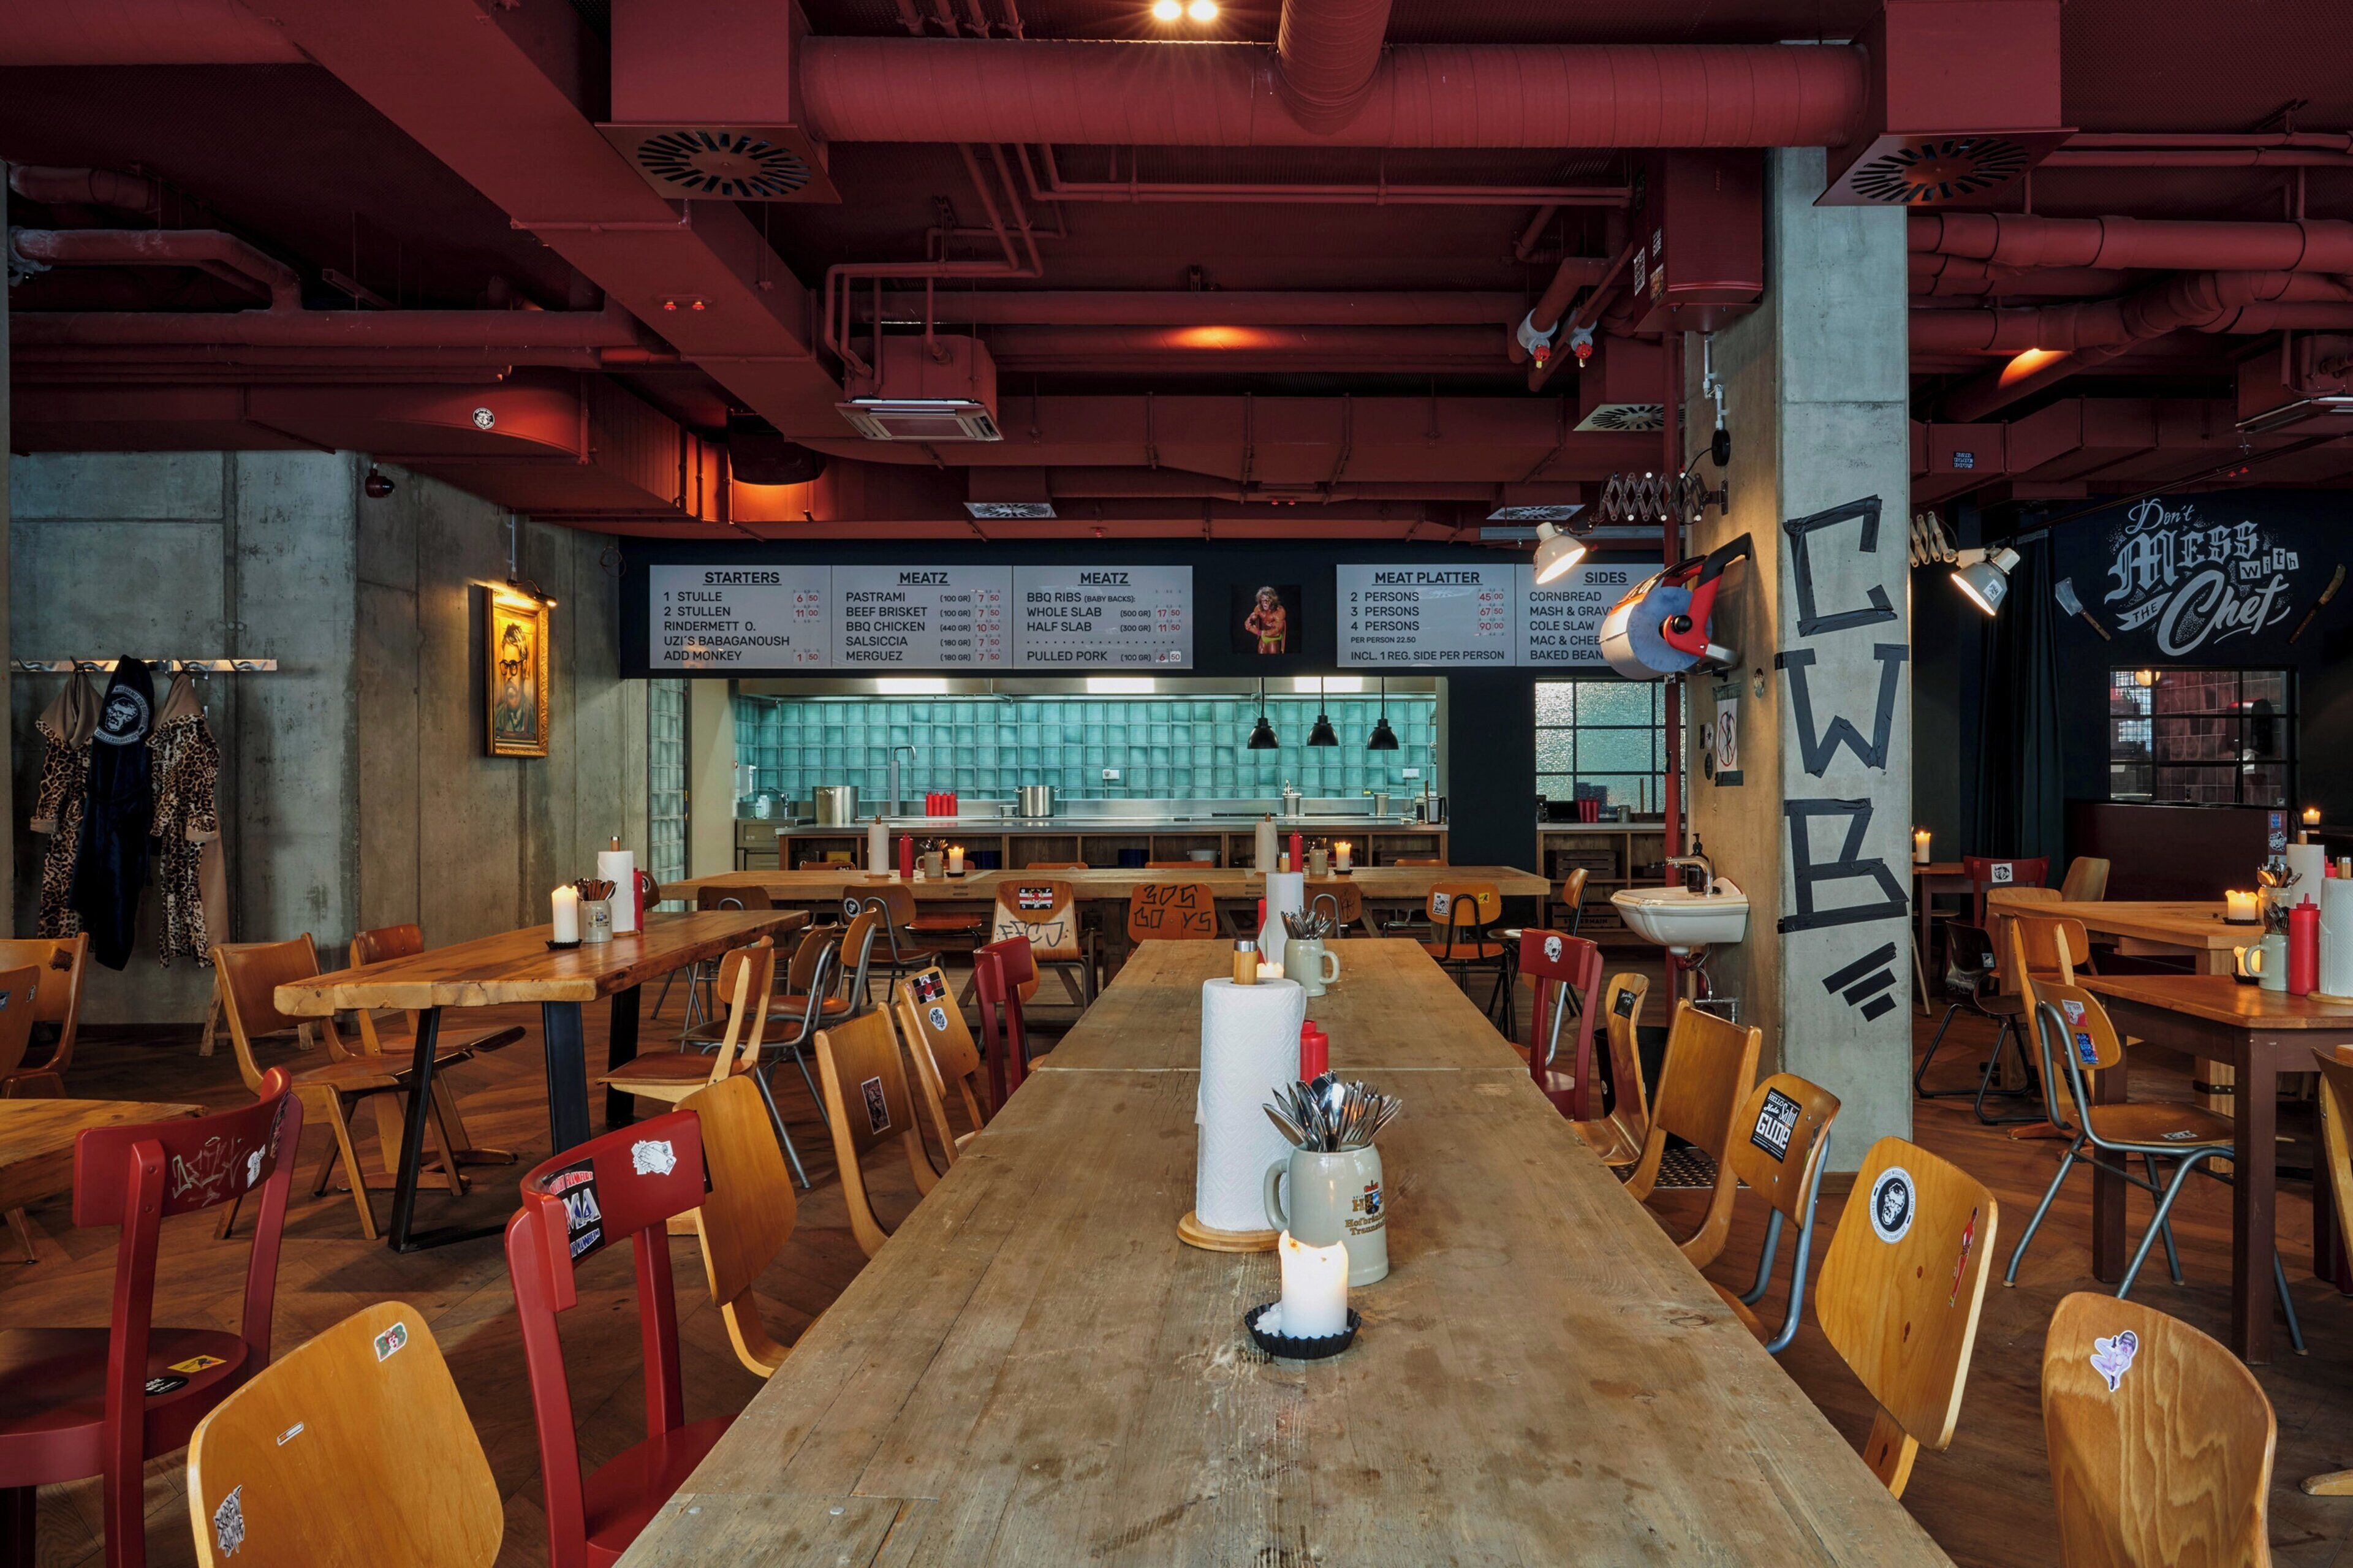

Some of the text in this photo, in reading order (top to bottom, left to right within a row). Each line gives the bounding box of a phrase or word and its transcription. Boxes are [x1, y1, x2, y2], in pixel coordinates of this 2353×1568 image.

[2124, 498, 2195, 534] Don't
[2240, 549, 2298, 578] with
[705, 572, 780, 583] STARTERS
[900, 572, 948, 584] MEATZ
[1080, 572, 1129, 584] MEATZ
[1375, 572, 1480, 584] MEAT PLATTER
[1585, 572, 1627, 583] SIDES
[664, 591, 669, 602] 1
[678, 591, 722, 602] STULLE
[797, 594, 803, 603] 6
[846, 592, 905, 602] PASTRAMI
[940, 594, 957, 603] (100
[958, 594, 971, 603] GR)
[979, 594, 984, 603] 7
[1027, 592, 1135, 604] BBQ RIBS (BABY BACKS):
[1351, 592, 1358, 602] 2
[1365, 591, 1419, 602] PERSONS
[1479, 593, 1491, 601] 45
[1529, 591, 1602, 602] CORNBREAD
[664, 606, 671, 616] 2
[678, 606, 730, 616] STULLEN
[795, 609, 804, 618] 11
[846, 607, 876, 617] BEEF
[879, 607, 928, 617] BRISKET
[940, 609, 957, 618] (100
[957, 609, 971, 618] GR)
[979, 609, 984, 618] 7
[1026, 607, 1067, 617] WHOLE
[1070, 607, 1102, 617] SLAB
[1120, 610, 1137, 618] (500
[1138, 610, 1151, 618] GR)
[1158, 609, 1167, 618] 17
[1351, 607, 1358, 616] 3
[1365, 606, 1420, 616] PERSONS
[1480, 607, 1491, 616] 67
[1529, 606, 1563, 616] MASH
[1567, 606, 1575, 616] &
[2132, 602, 2159, 623] THE
[2157, 570, 2290, 656] Chef
[664, 621, 756, 631] RINDERMETT O.
[846, 621, 871, 632] BBQ
[874, 621, 925, 632] CHICKEN
[940, 624, 957, 632] (440
[957, 624, 971, 632] GR)
[976, 623, 987, 632] 10
[1027, 621, 1058, 632] HALF
[1061, 621, 1092, 632] SLAB
[1120, 624, 1137, 633] (300
[1138, 624, 1151, 633] GR)
[1158, 624, 1167, 632] 11
[1351, 621, 1358, 631] 4
[1365, 621, 1420, 631] PERSONS
[1479, 622, 1491, 631] 90
[1529, 621, 1594, 631] COLE SLAW
[699, 635, 790, 646] BABAGANOUSH
[846, 636, 908, 646] SALSICCIA
[940, 638, 957, 647] (180
[958, 638, 971, 647] GR)
[1530, 635, 1556, 645] MAC
[1559, 635, 1567, 646] &
[664, 650, 689, 661] ADD
[692, 650, 742, 661] MONKEY
[797, 653, 801, 662] 1
[846, 651, 903, 661] MERGUEZ
[940, 653, 957, 662] (180
[958, 653, 971, 662] GR)
[1027, 651, 1073, 661] PULLED
[1076, 651, 1107, 661] PORK
[1120, 654, 1137, 662] (100
[1138, 653, 1151, 662] GR)
[1351, 650, 1504, 661] INCL. 1 REG. SIDE PER PERSON
[1530, 650, 1569, 660] BAKED
[1767, 1093, 1784, 1107] HELLO
